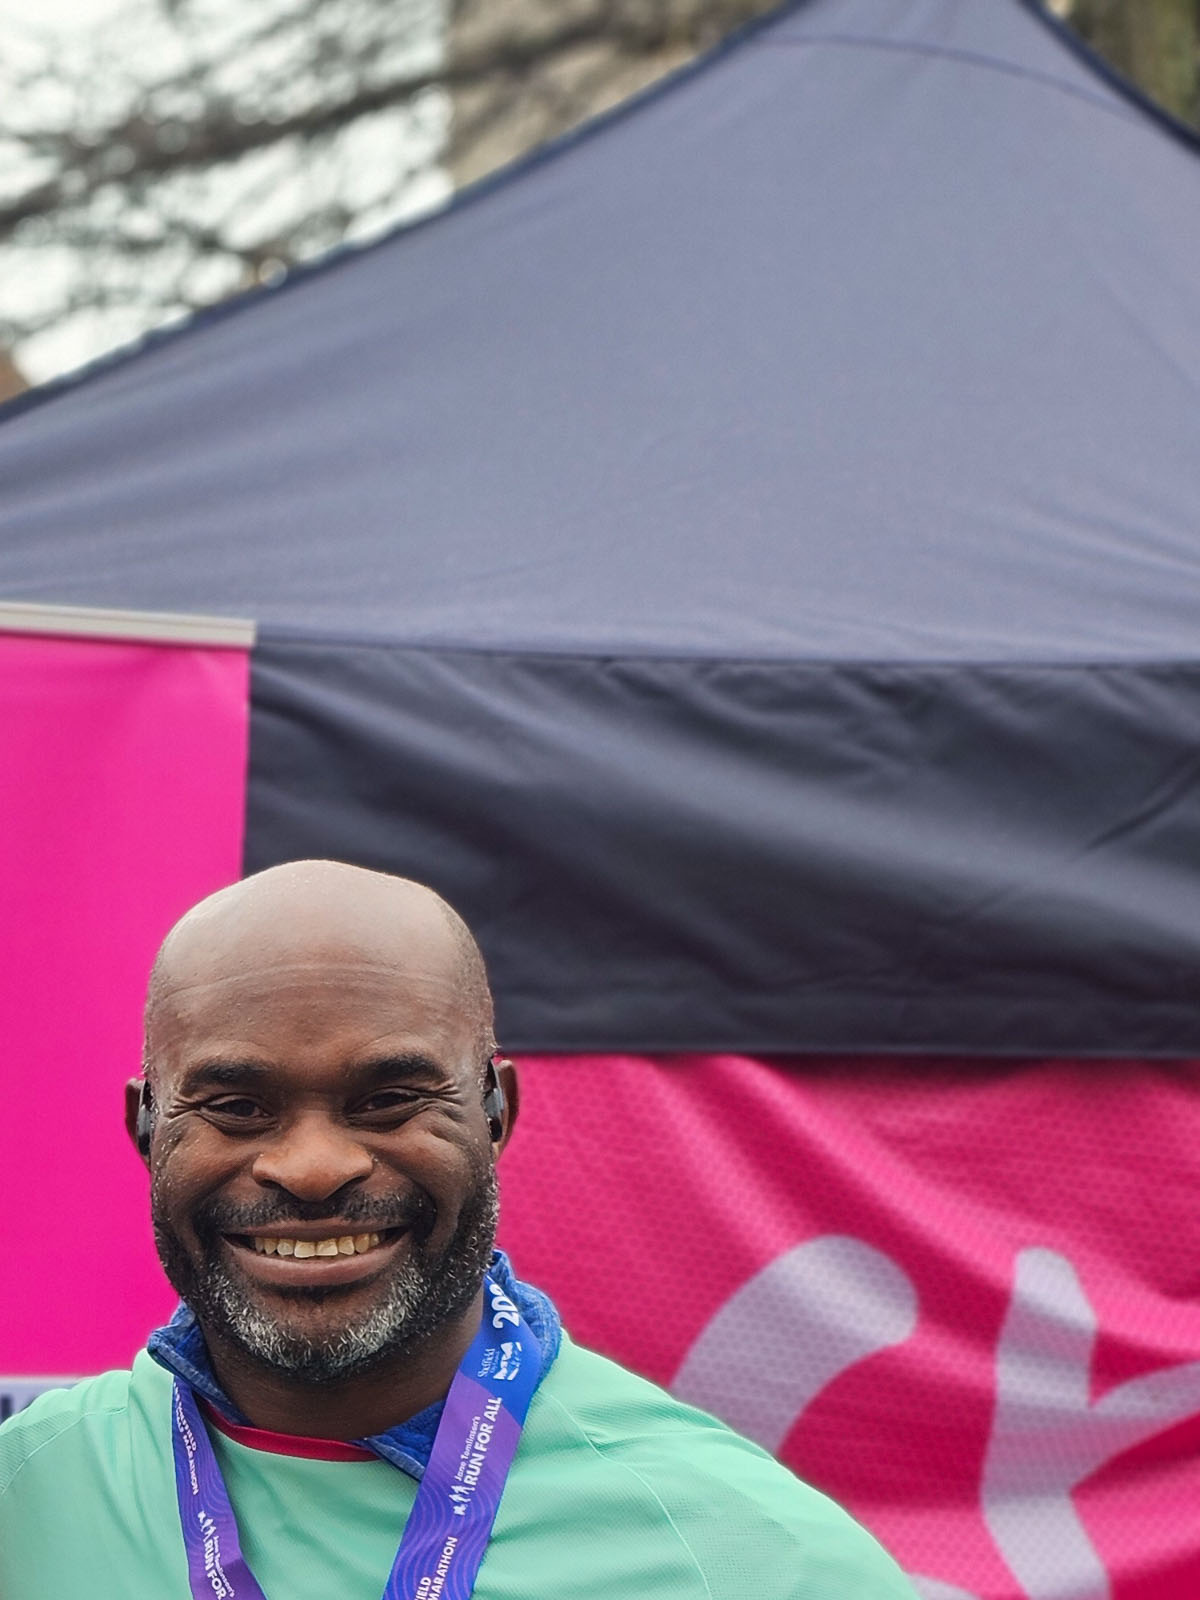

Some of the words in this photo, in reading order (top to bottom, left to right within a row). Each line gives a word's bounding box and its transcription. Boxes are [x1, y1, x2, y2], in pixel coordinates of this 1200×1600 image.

[483, 1396, 503, 1423] ALL
[474, 1422, 495, 1453] FOR
[453, 1460, 467, 1482] Jane
[463, 1451, 486, 1487] RUN
[204, 1539, 216, 1571] RUN
[206, 1569, 228, 1600] FOR
